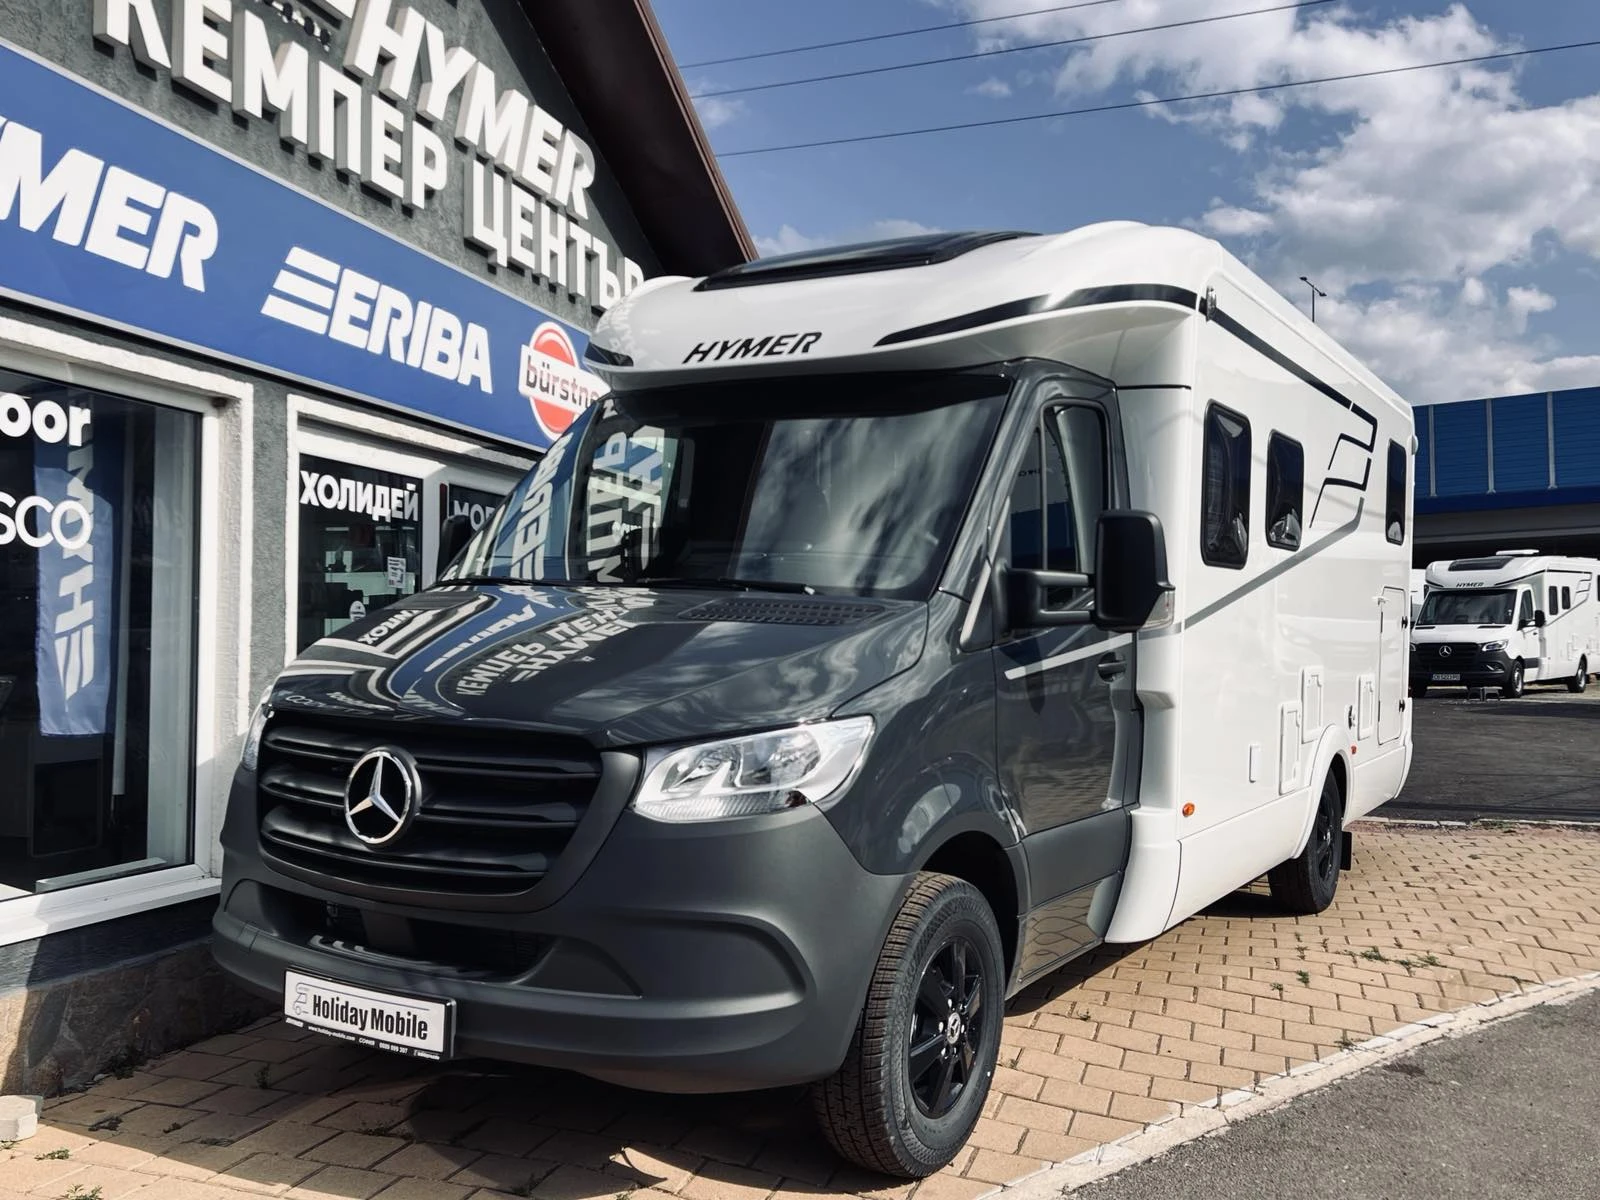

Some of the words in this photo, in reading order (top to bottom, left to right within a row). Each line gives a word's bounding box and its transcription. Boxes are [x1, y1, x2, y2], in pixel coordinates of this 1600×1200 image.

[345, 0, 596, 219] HYMER
[0, 115, 219, 292] MER
[329, 267, 493, 394] ERIBA
[681, 331, 823, 365] HYMER
[299, 470, 419, 523] ХОЛИДЕЙ
[312, 994, 369, 1031] Holiday
[371, 1008, 428, 1041] Mobile
